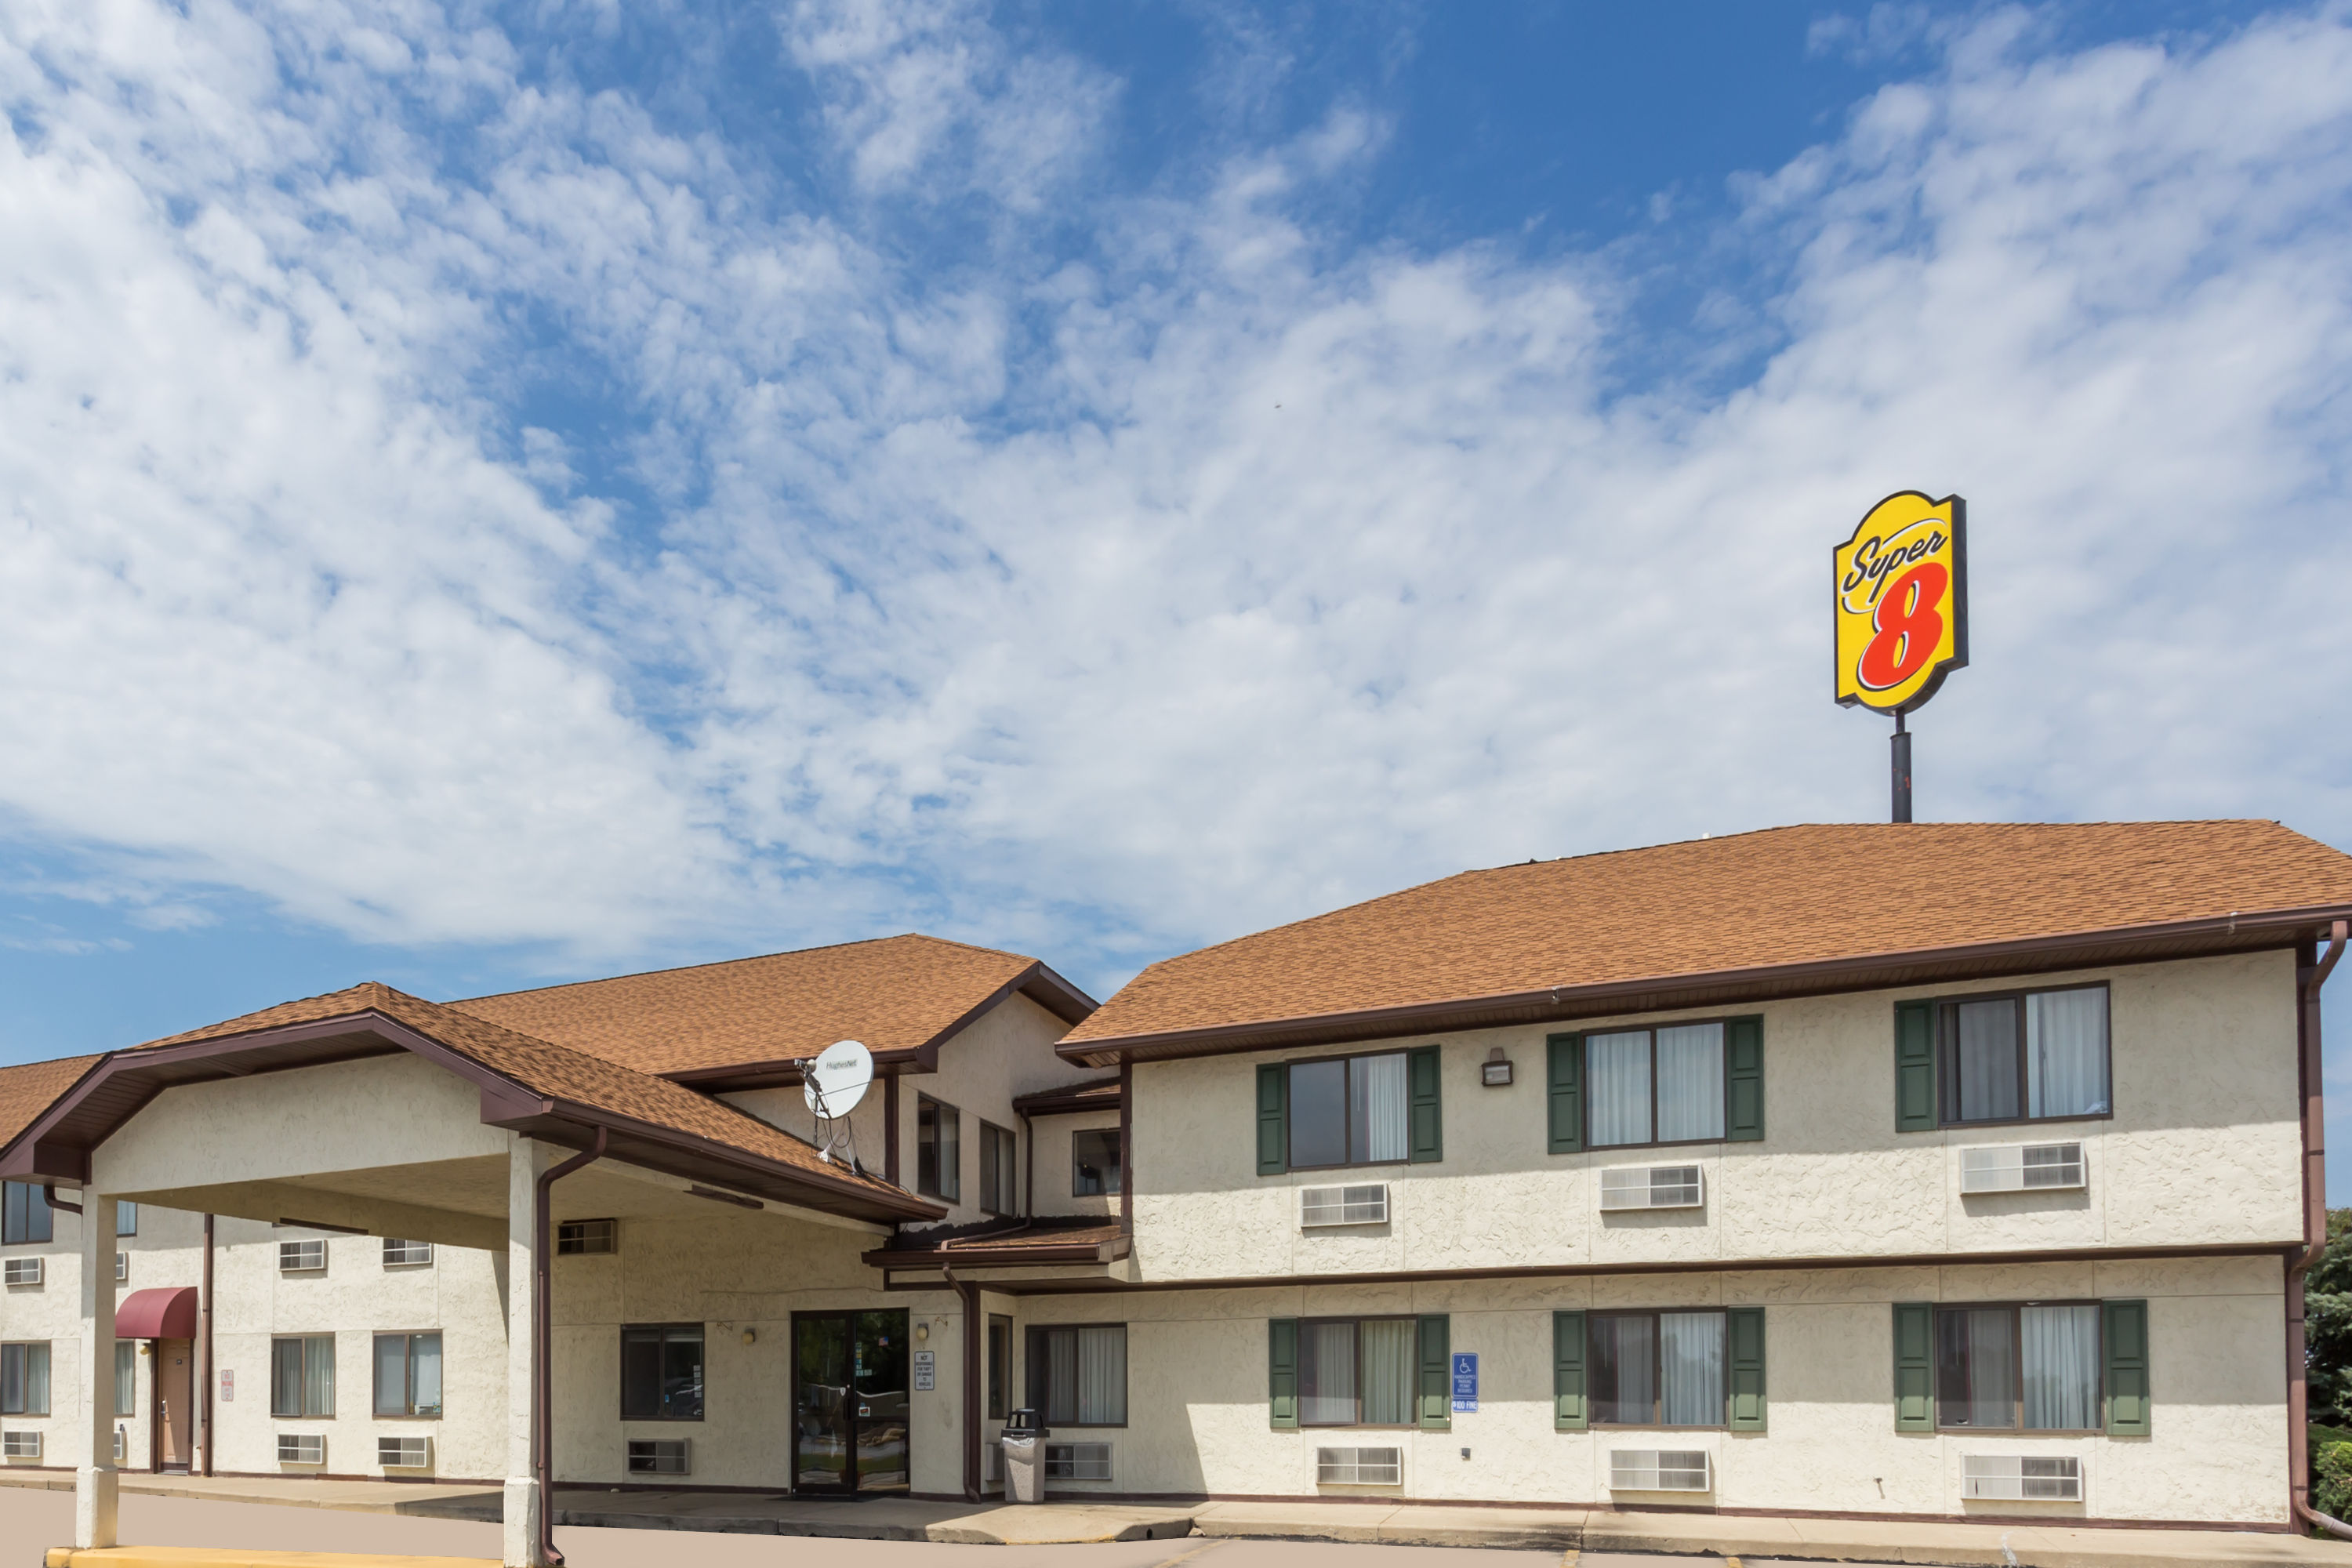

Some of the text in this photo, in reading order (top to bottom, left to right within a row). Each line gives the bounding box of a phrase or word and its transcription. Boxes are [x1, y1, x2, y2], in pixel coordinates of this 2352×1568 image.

[1841, 531, 1948, 606] Super
[1856, 561, 1948, 691] 8
[1466, 1400, 1478, 1410] FINE
